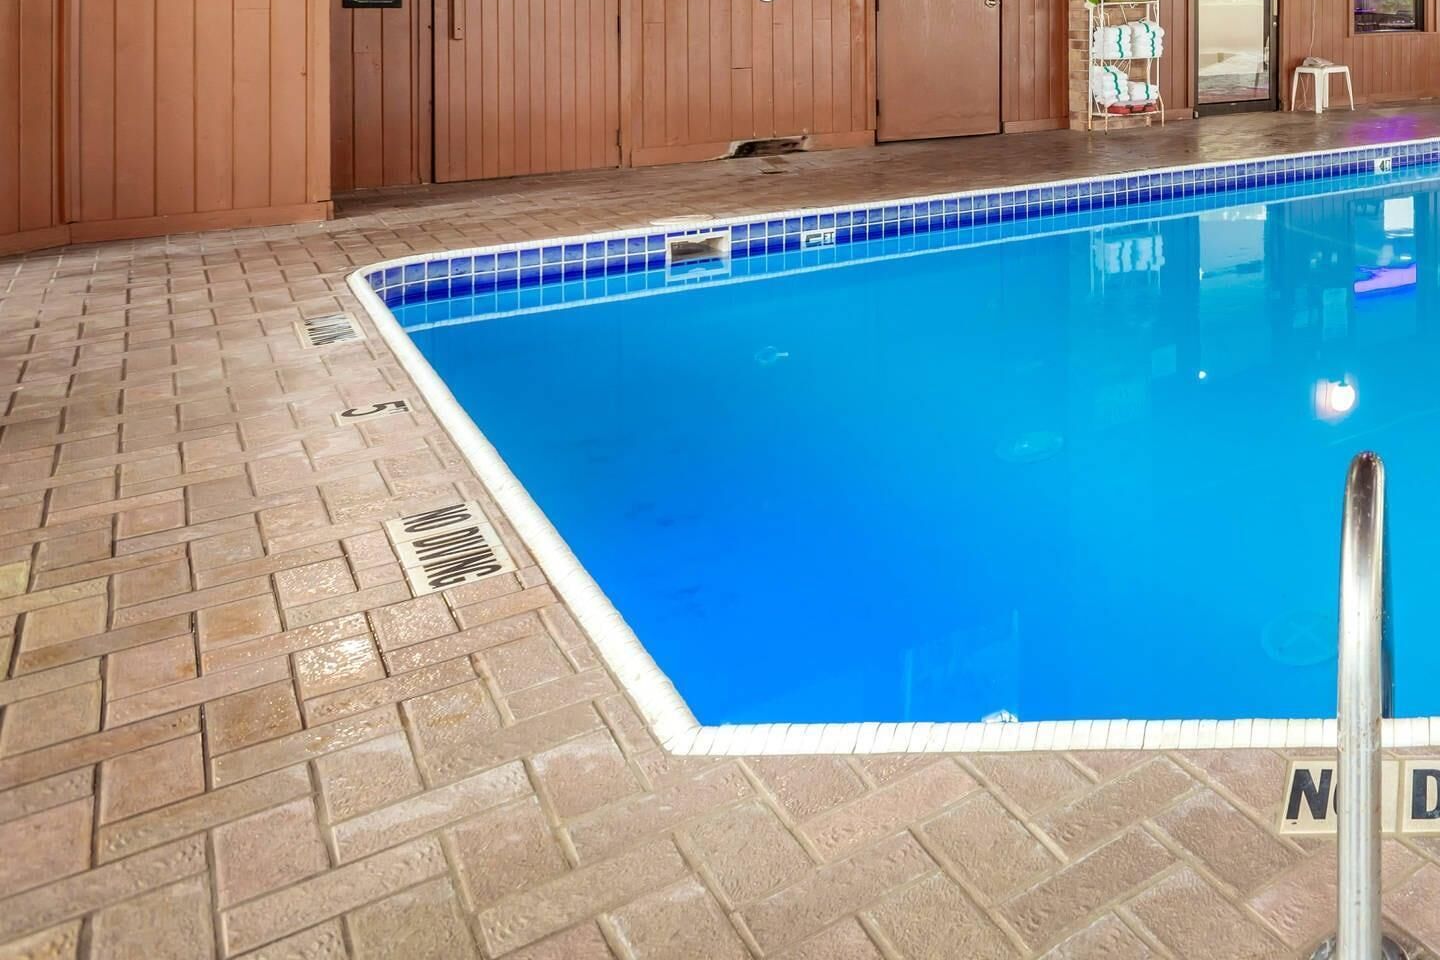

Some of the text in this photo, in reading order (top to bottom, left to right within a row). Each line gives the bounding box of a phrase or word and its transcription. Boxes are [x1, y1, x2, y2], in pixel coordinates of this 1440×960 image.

[402, 503, 502, 590] NO DIVING
[1286, 768, 1338, 821] N
